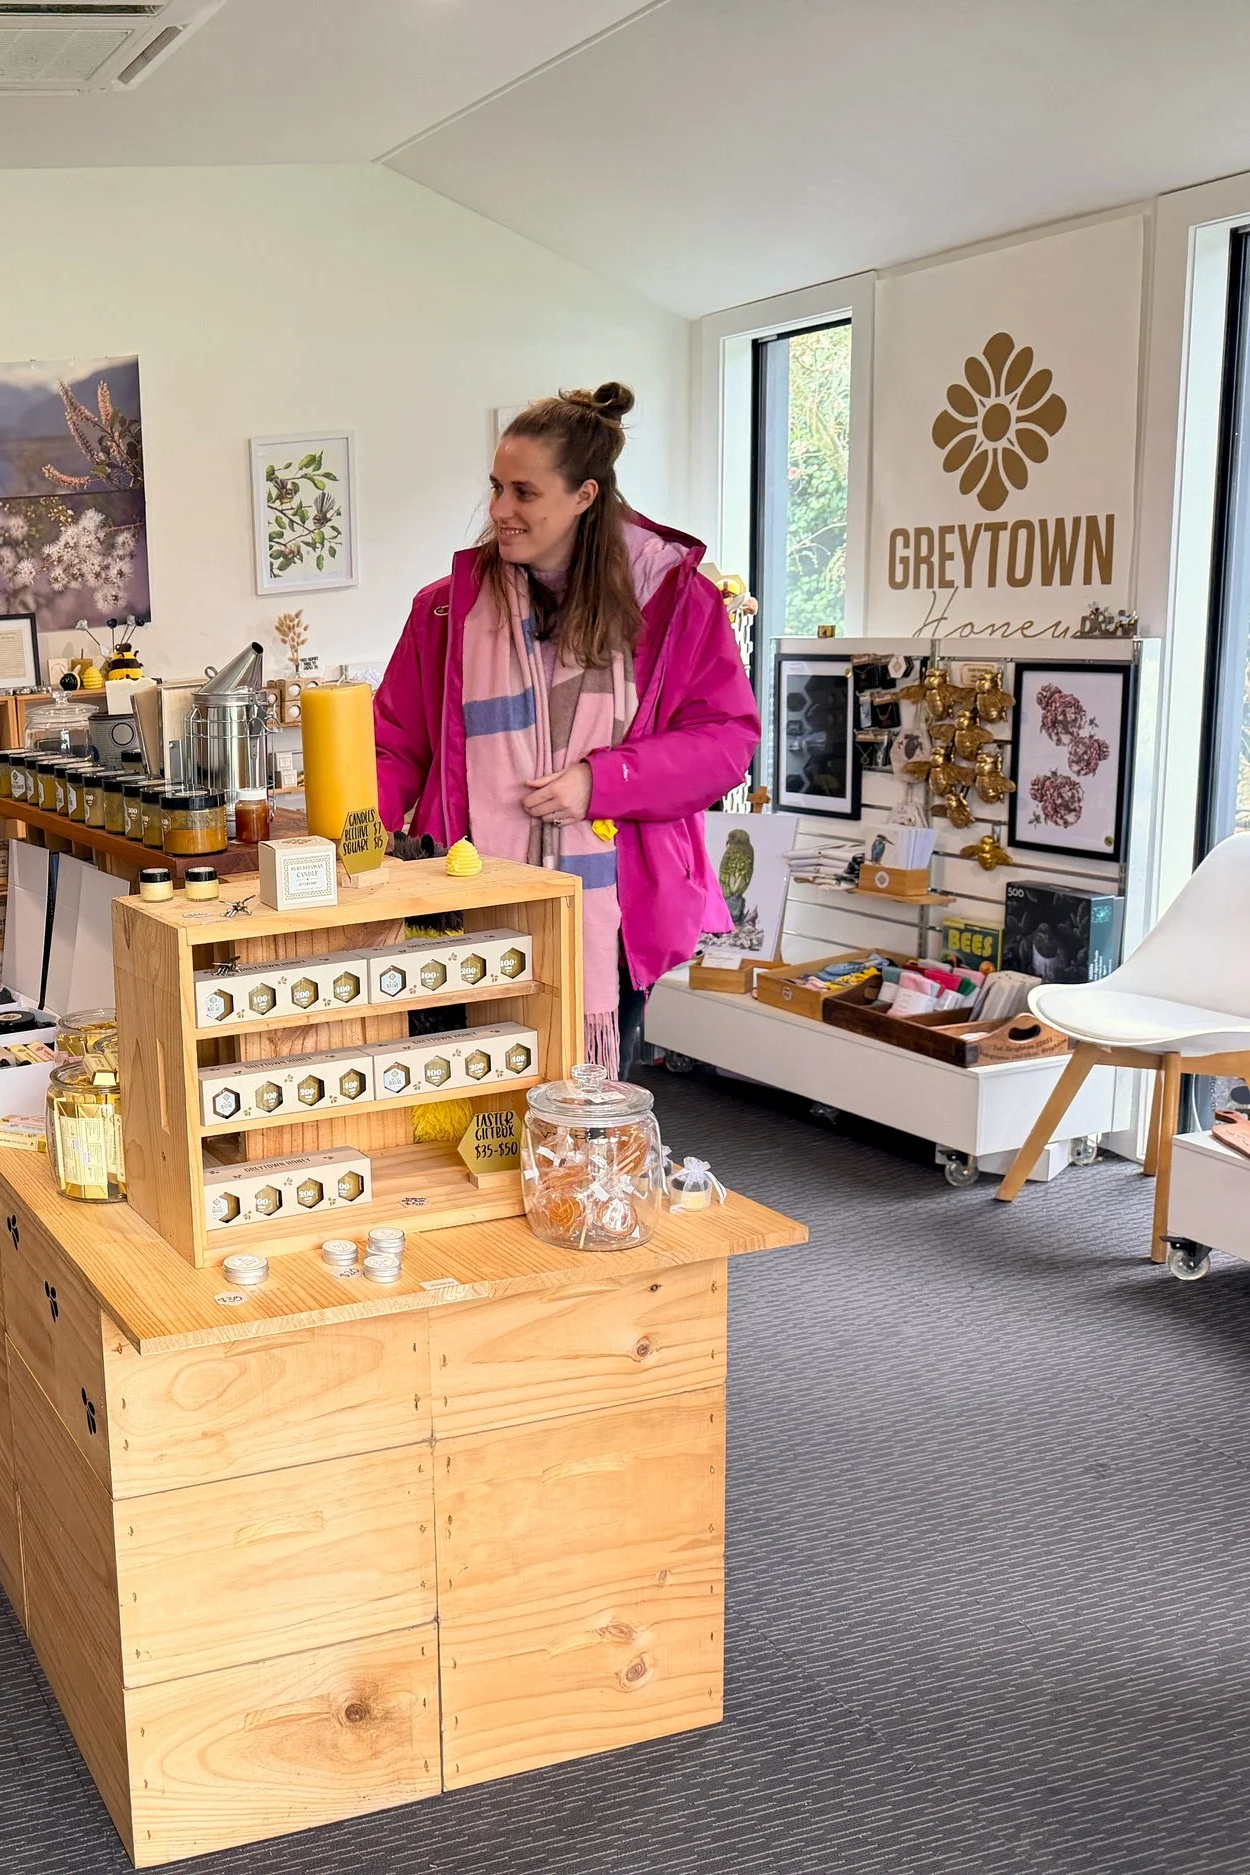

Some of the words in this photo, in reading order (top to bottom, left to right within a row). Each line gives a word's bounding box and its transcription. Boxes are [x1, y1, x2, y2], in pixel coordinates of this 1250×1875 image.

[888, 513, 1115, 590] GREYTOWN
[349, 809, 375, 826] CANDLES
[345, 824, 369, 841] BEEHIVE
[373, 822, 382, 836] $7
[342, 838, 369, 856] SQUARE
[373, 836, 383, 850] $15
[296, 870, 319, 878] CANDLE
[1007, 887, 1024, 898] 500
[948, 928, 994, 957] BEES
[475, 1111, 514, 1128] TASTER
[475, 1124, 515, 1141] GIFTBOX
[474, 1141, 518, 1160] $35-$50
